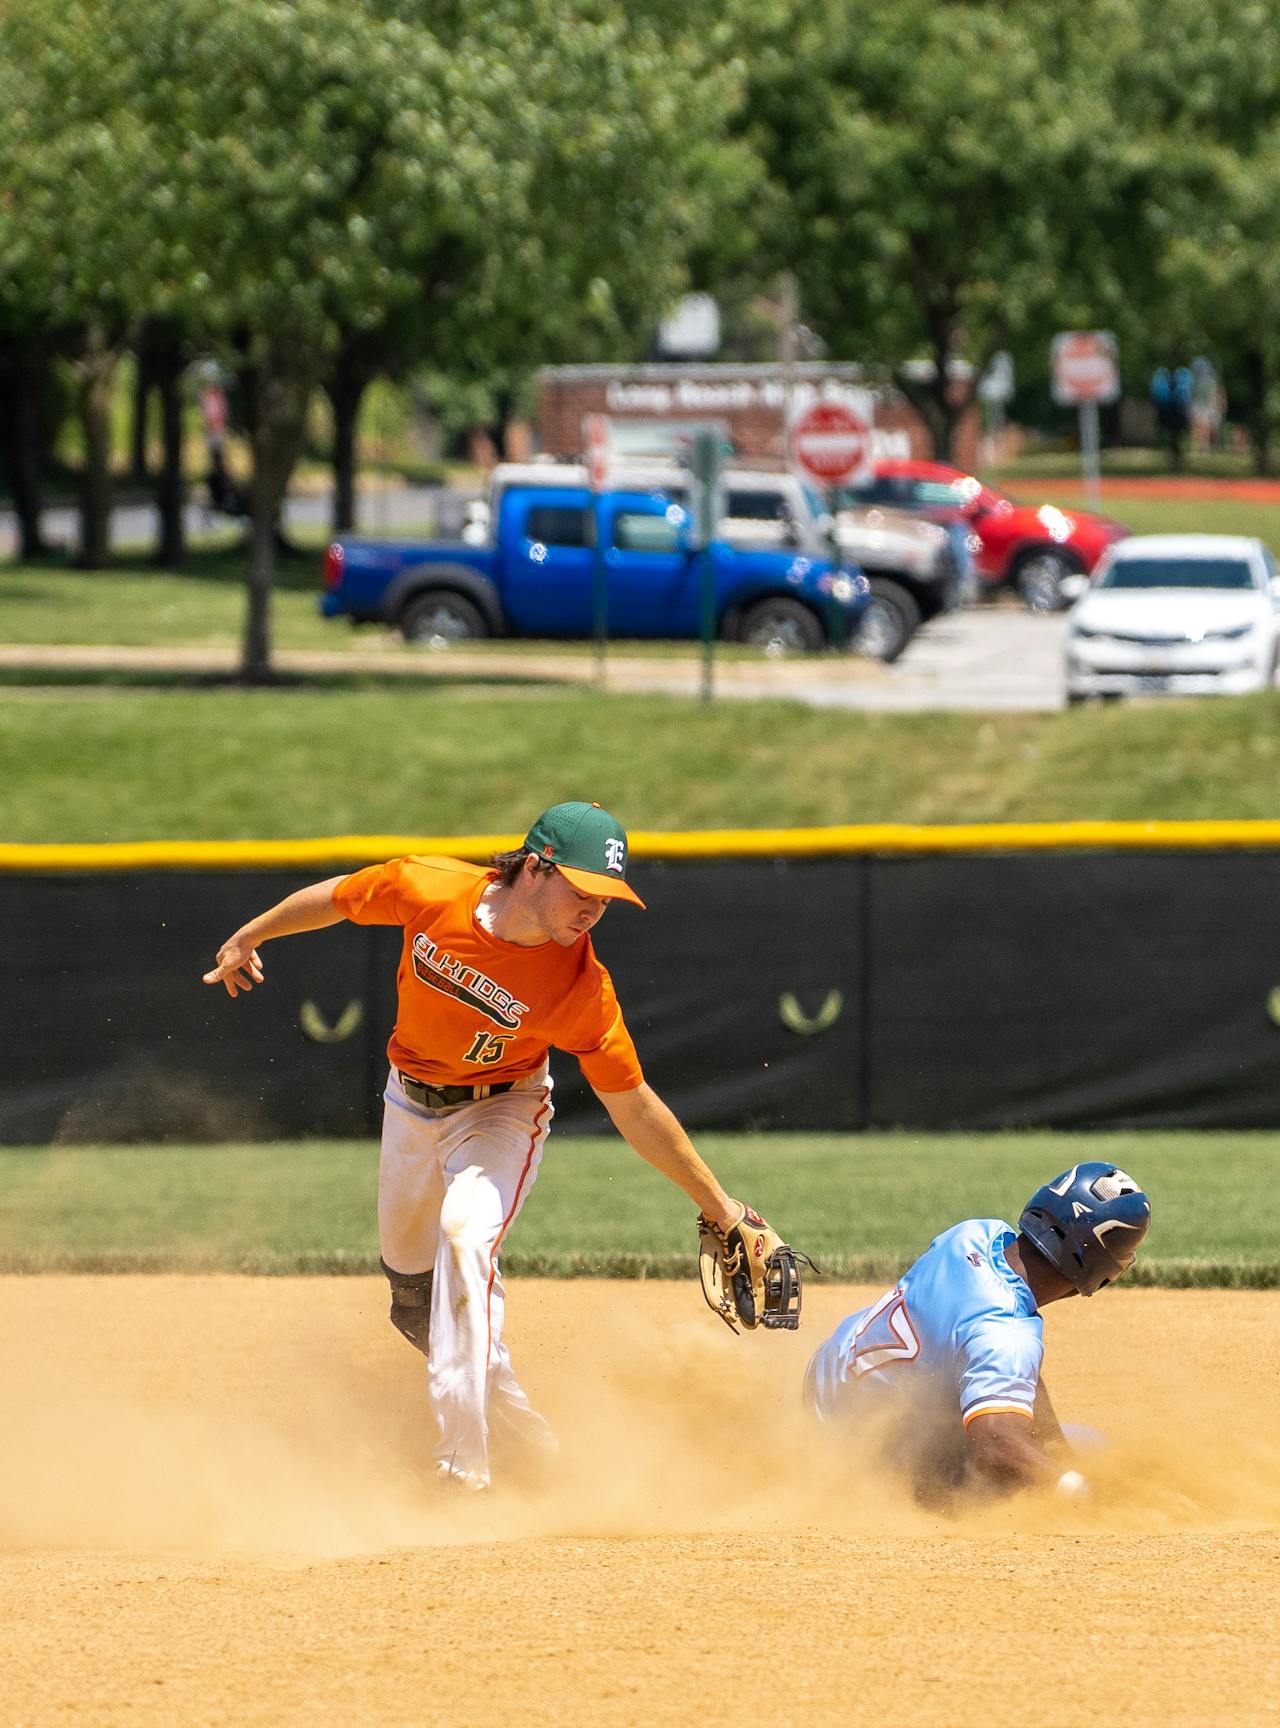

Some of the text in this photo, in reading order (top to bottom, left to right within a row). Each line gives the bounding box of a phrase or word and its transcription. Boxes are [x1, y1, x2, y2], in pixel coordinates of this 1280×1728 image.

[605, 838, 624, 872] E
[412, 932, 530, 1023] ELKRIDGE
[462, 1030, 516, 1066] 15
